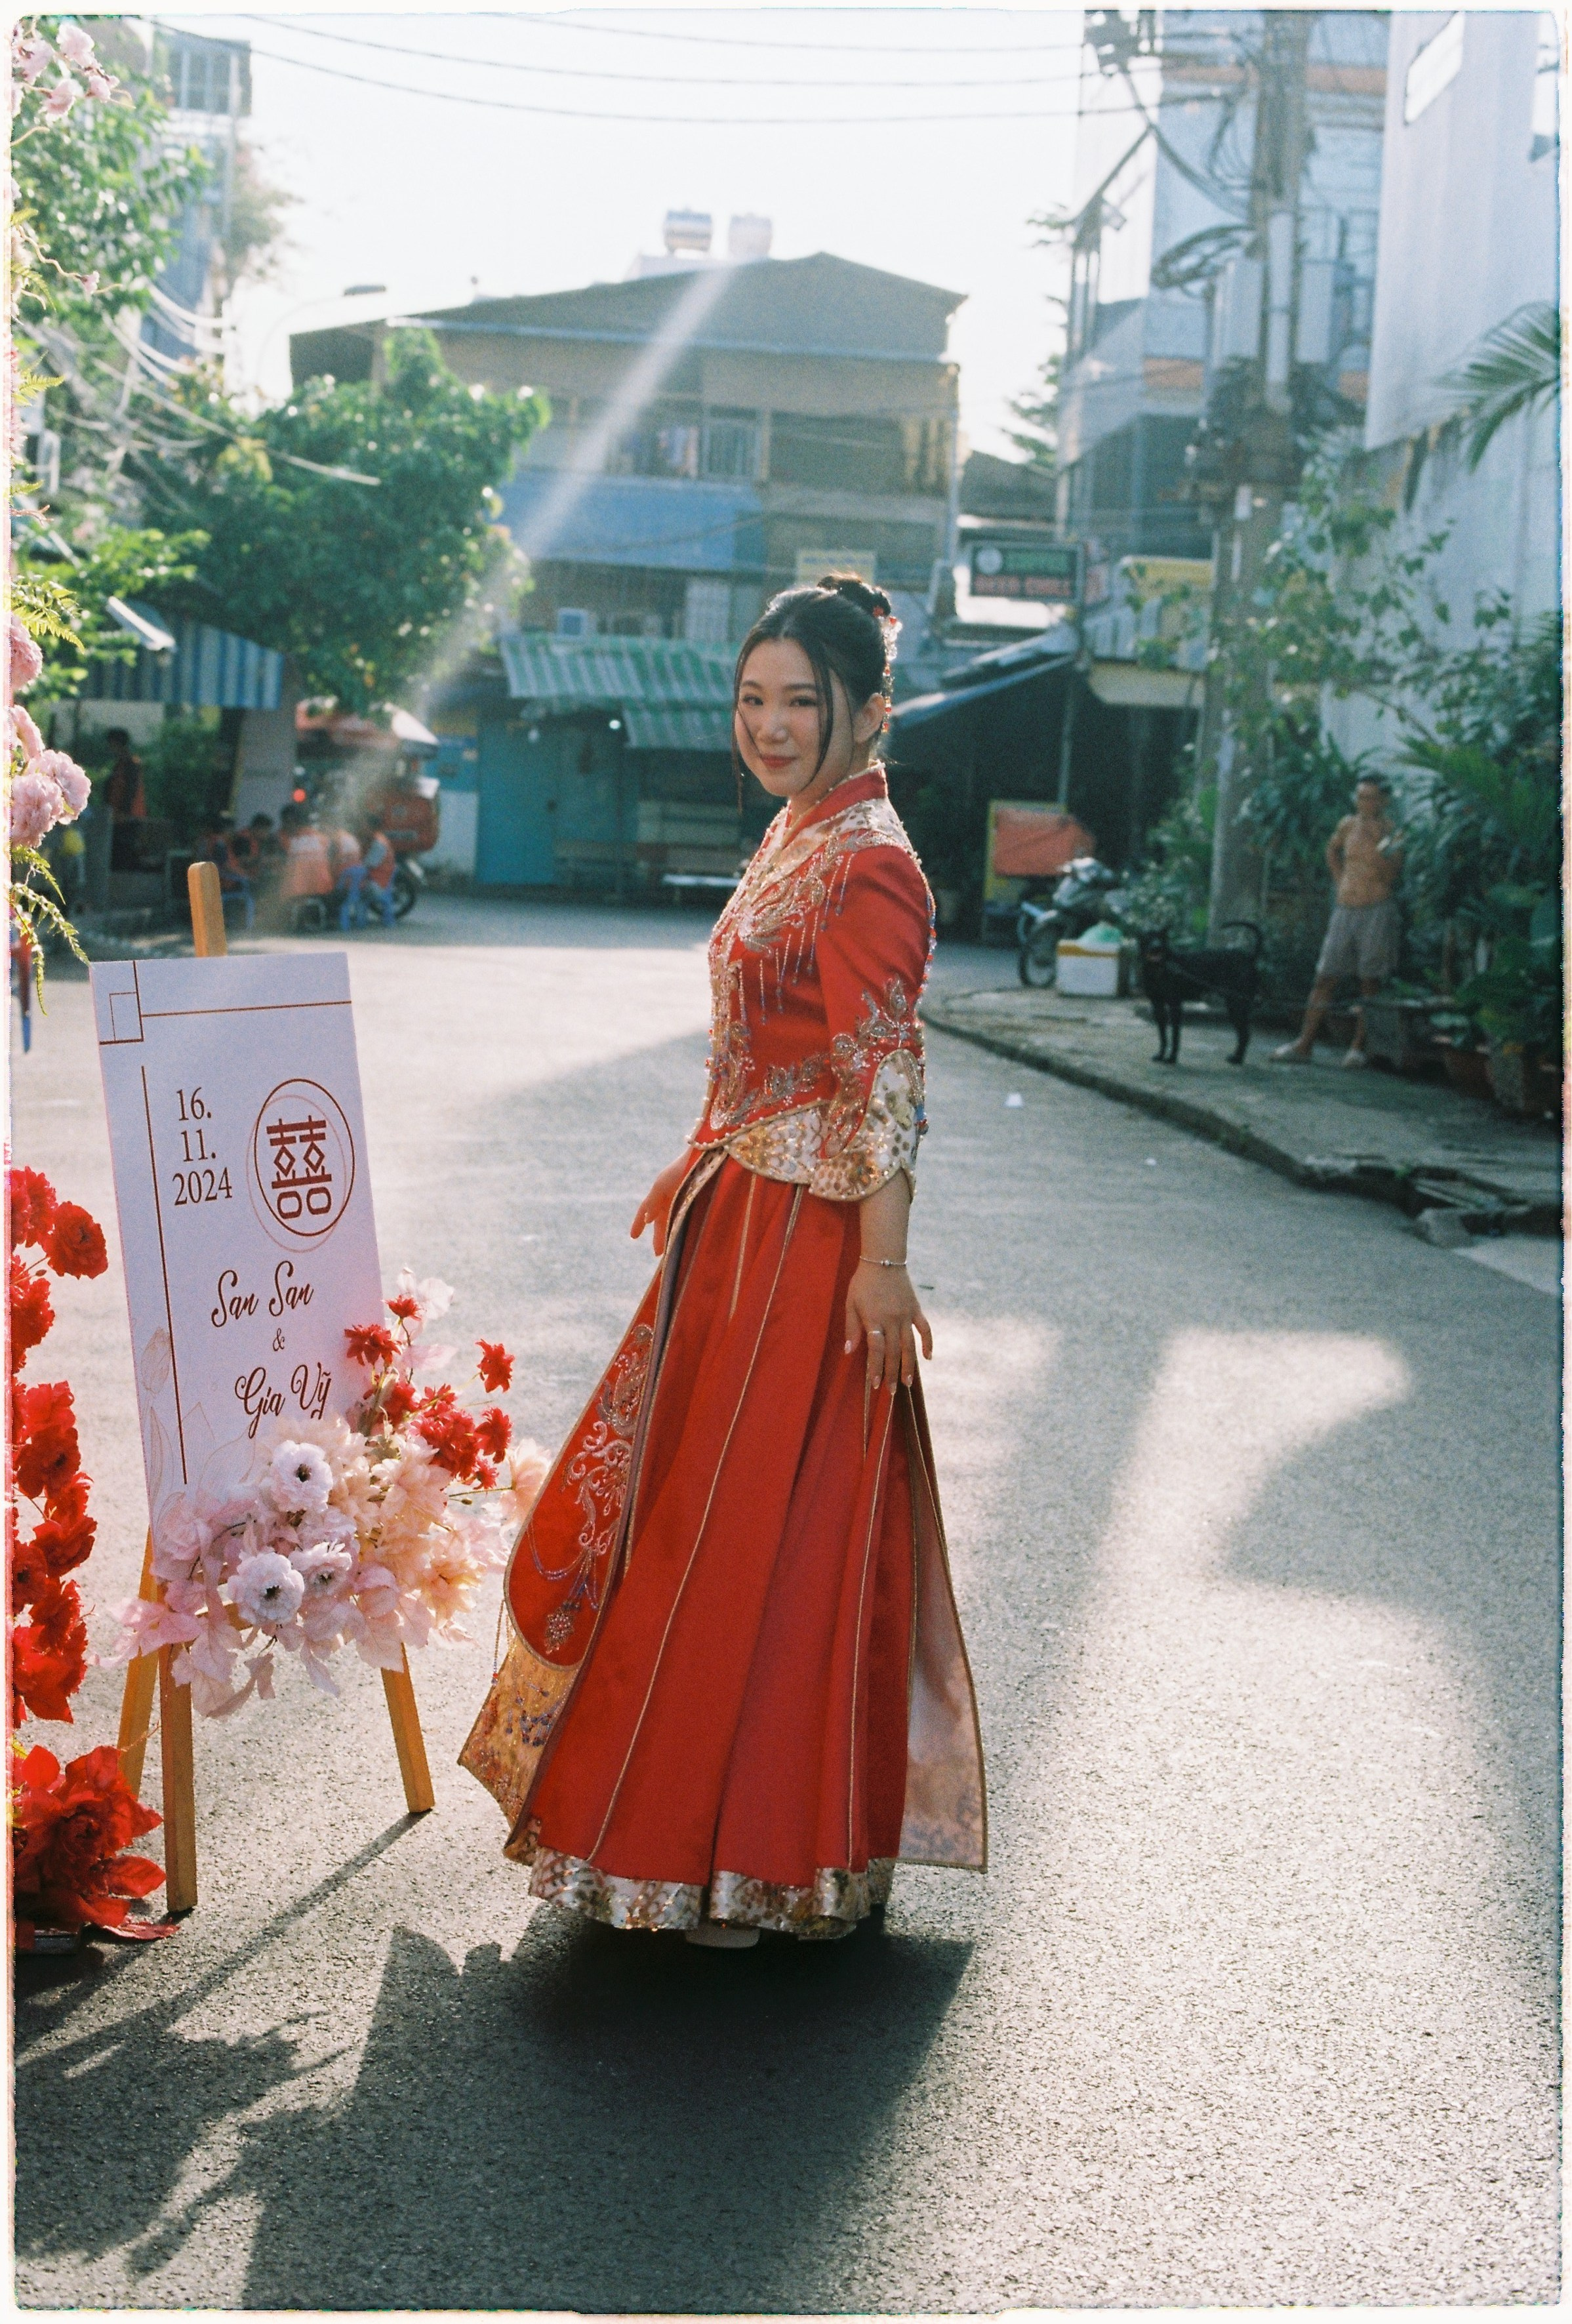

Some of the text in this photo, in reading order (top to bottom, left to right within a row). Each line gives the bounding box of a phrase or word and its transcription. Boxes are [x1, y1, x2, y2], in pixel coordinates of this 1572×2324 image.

[176, 1086, 212, 1122] 16.
[180, 1128, 216, 1162] 11.
[172, 1167, 233, 1206] 2024
[211, 1260, 314, 1328] San San
[272, 1328, 285, 1352] &
[234, 1362, 332, 1440] Gia Vỹ
